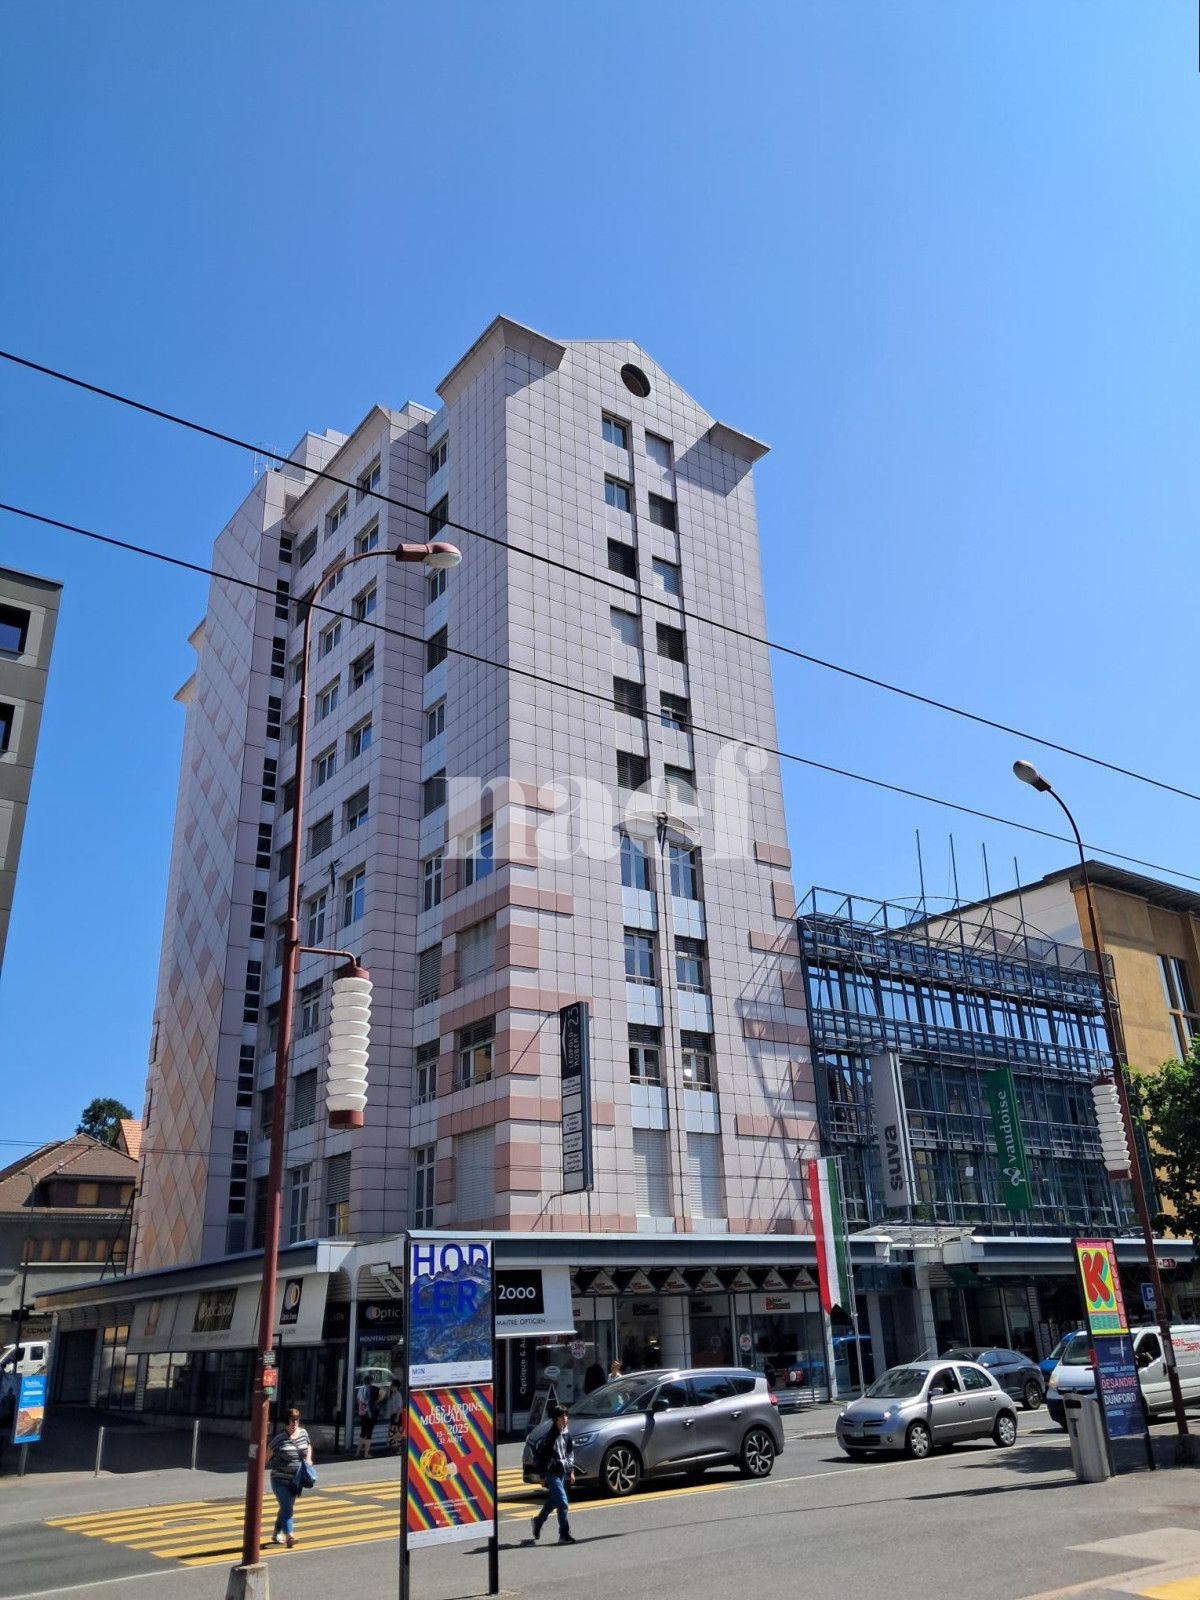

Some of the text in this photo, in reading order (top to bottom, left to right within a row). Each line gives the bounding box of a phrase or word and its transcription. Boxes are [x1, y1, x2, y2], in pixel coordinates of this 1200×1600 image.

[567, 1006, 579, 1027] 23
[998, 1091, 1018, 1164] vaudoise
[884, 1125, 903, 1192] suva
[413, 1243, 489, 1277] HOD
[1101, 1376, 1138, 1389] DESANDRE
[1104, 1392, 1137, 1405] DUNFORD
[447, 1423, 469, 1434] 2025
